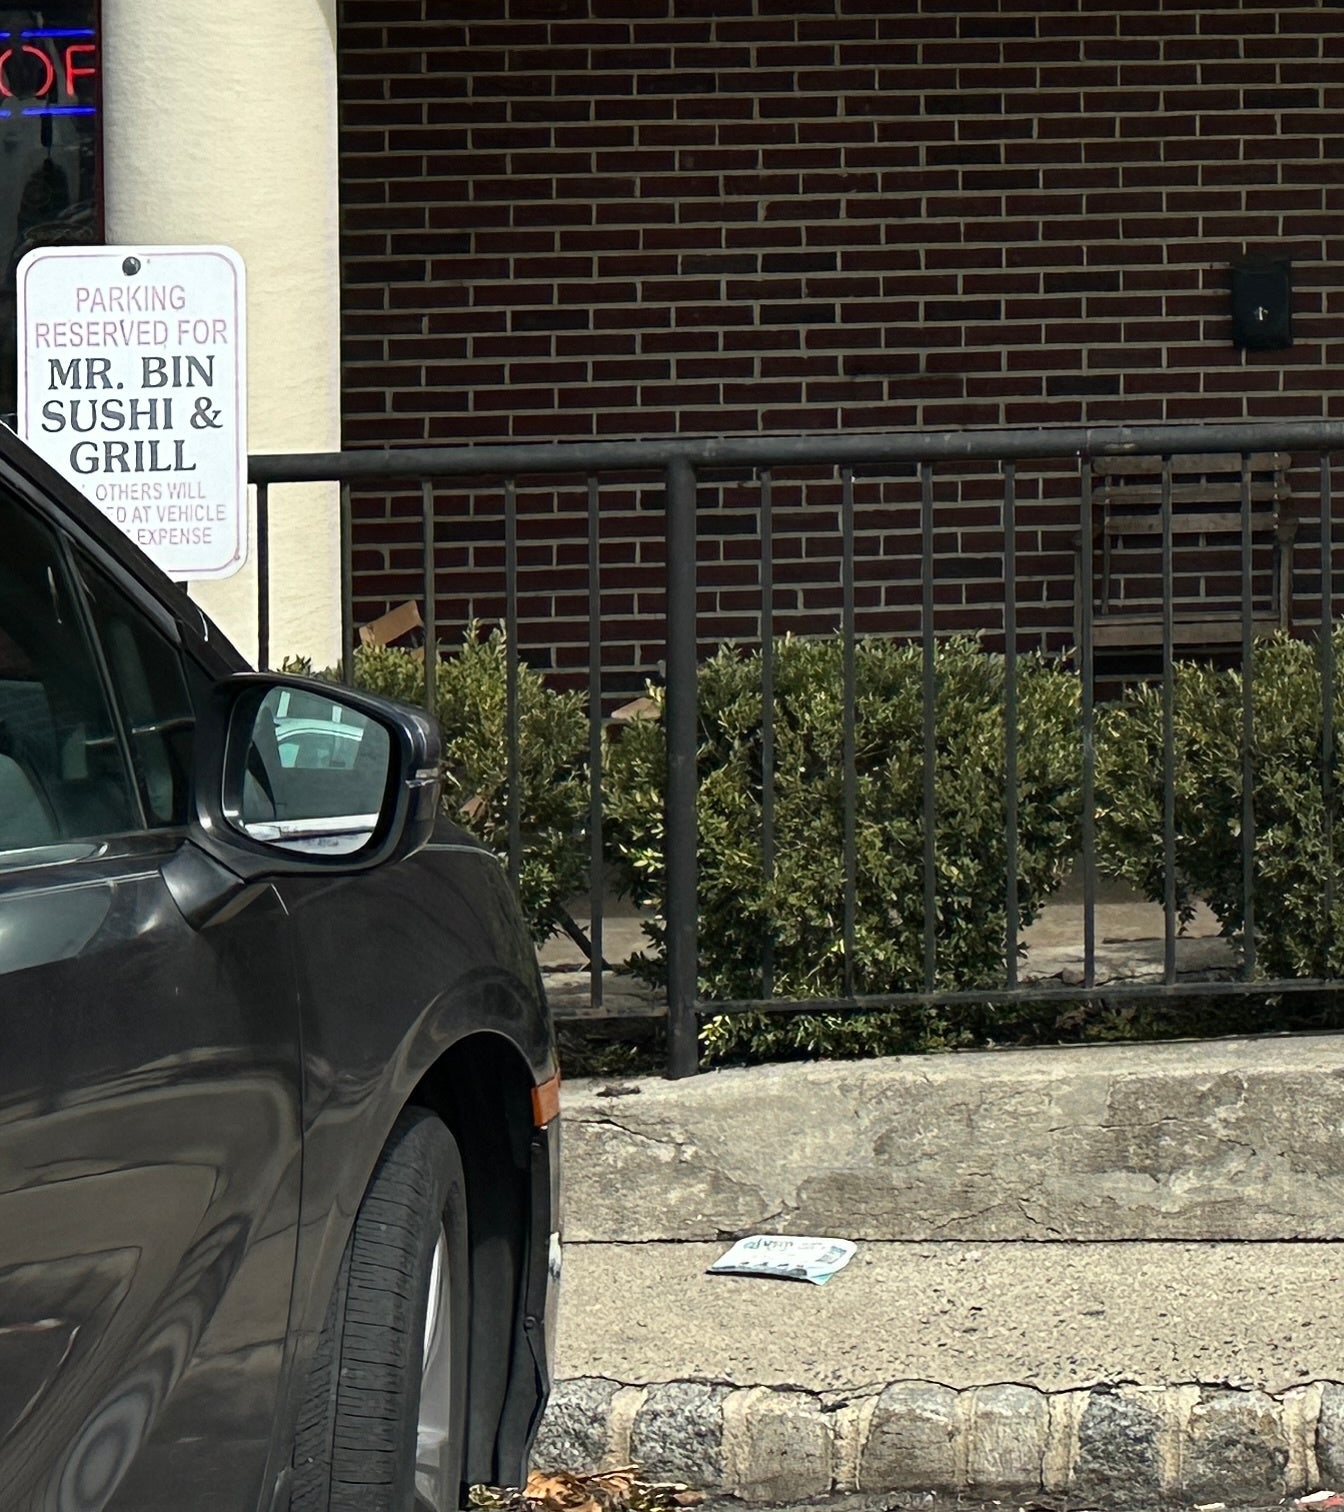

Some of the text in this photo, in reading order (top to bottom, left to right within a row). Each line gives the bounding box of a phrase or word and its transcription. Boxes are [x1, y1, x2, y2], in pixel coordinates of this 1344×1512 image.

[75, 285, 187, 314] PARKING
[35, 319, 229, 349] RESERVED FOR
[47, 355, 216, 390] MR. BIN
[41, 396, 224, 433] SUSHI &
[69, 439, 197, 474] GRILL
[95, 481, 207, 502] OTHERS WILL
[131, 506, 152, 524] AT
[156, 504, 228, 523] VEHICLE
[137, 527, 213, 545] EXPENSE
